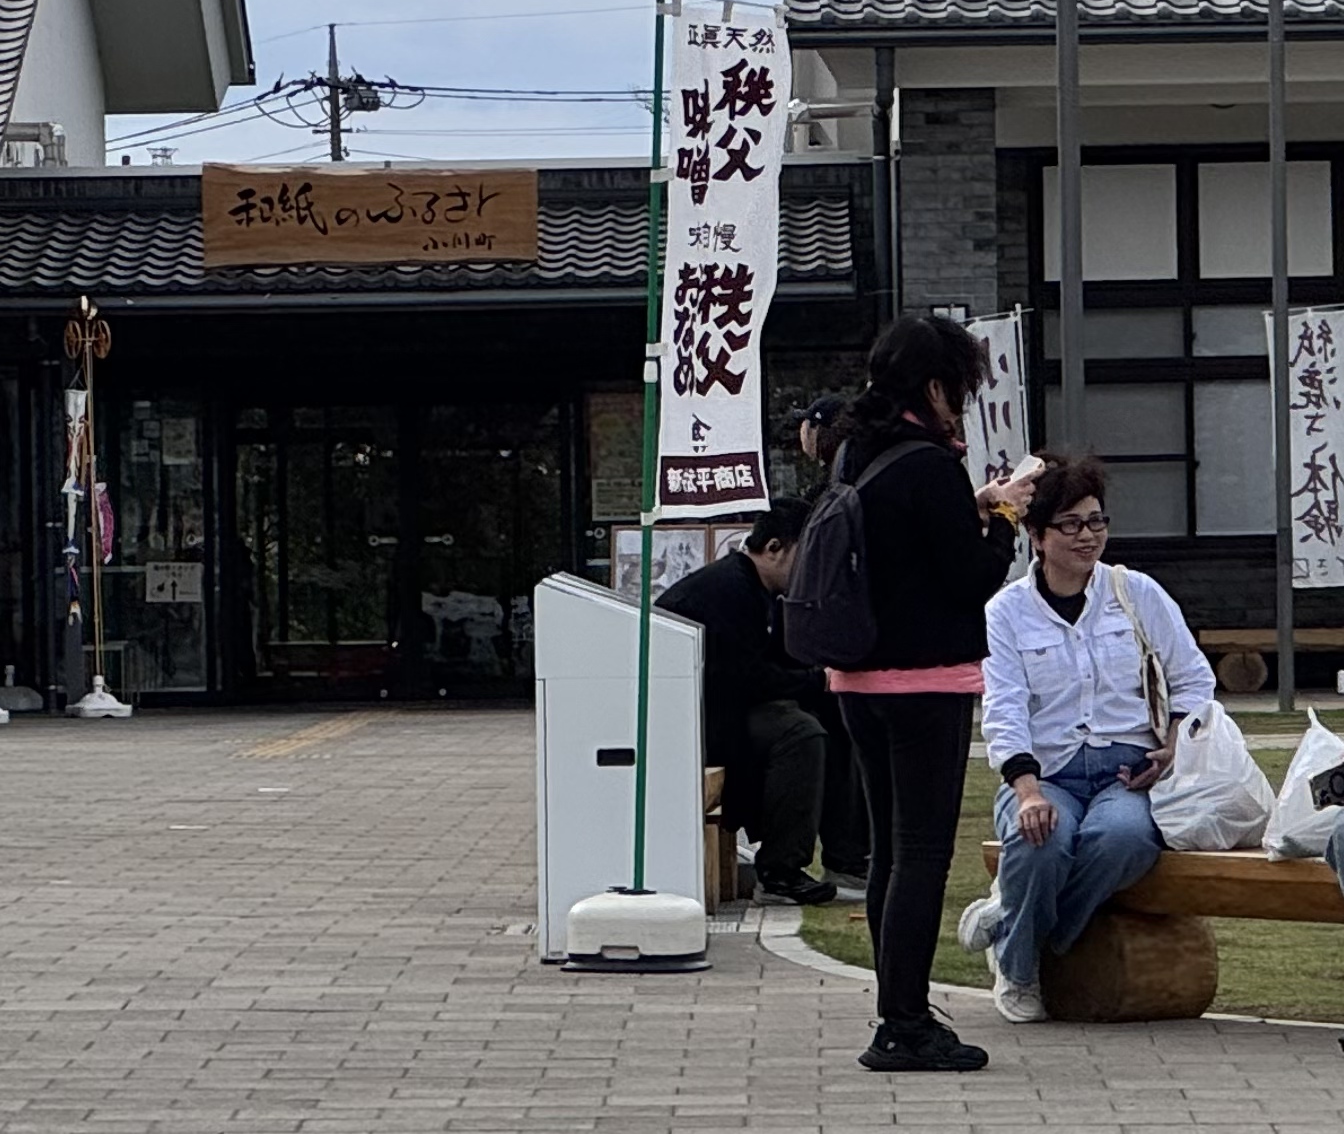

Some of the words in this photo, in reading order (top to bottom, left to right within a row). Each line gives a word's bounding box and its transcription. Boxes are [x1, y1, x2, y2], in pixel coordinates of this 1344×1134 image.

[712, 57, 777, 182] 秩父
[228, 182, 501, 235] 和紙のふるさと
[422, 232, 497, 251] 小川町
